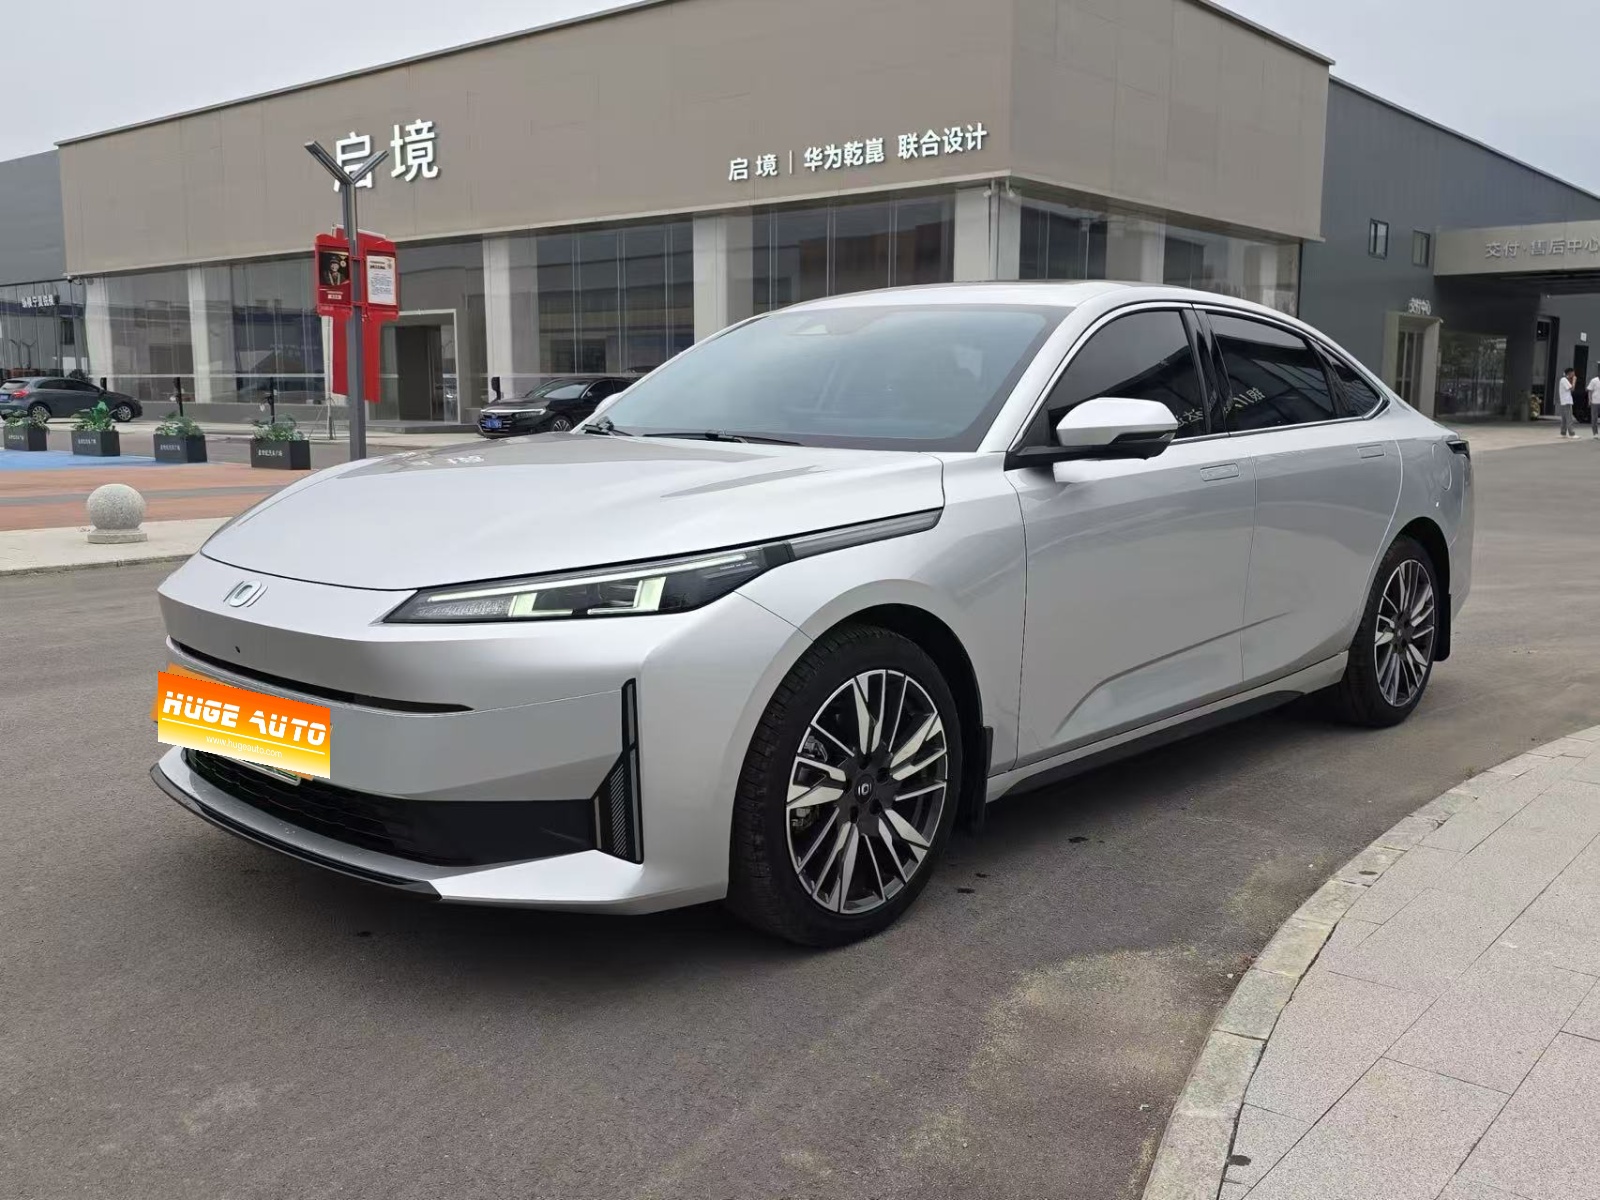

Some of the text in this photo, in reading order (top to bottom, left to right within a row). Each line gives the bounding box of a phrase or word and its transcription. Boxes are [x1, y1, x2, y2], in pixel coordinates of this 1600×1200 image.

[333, 118, 439, 192] 启境
[728, 122, 988, 182] 启境 华为乾崑 联合设计
